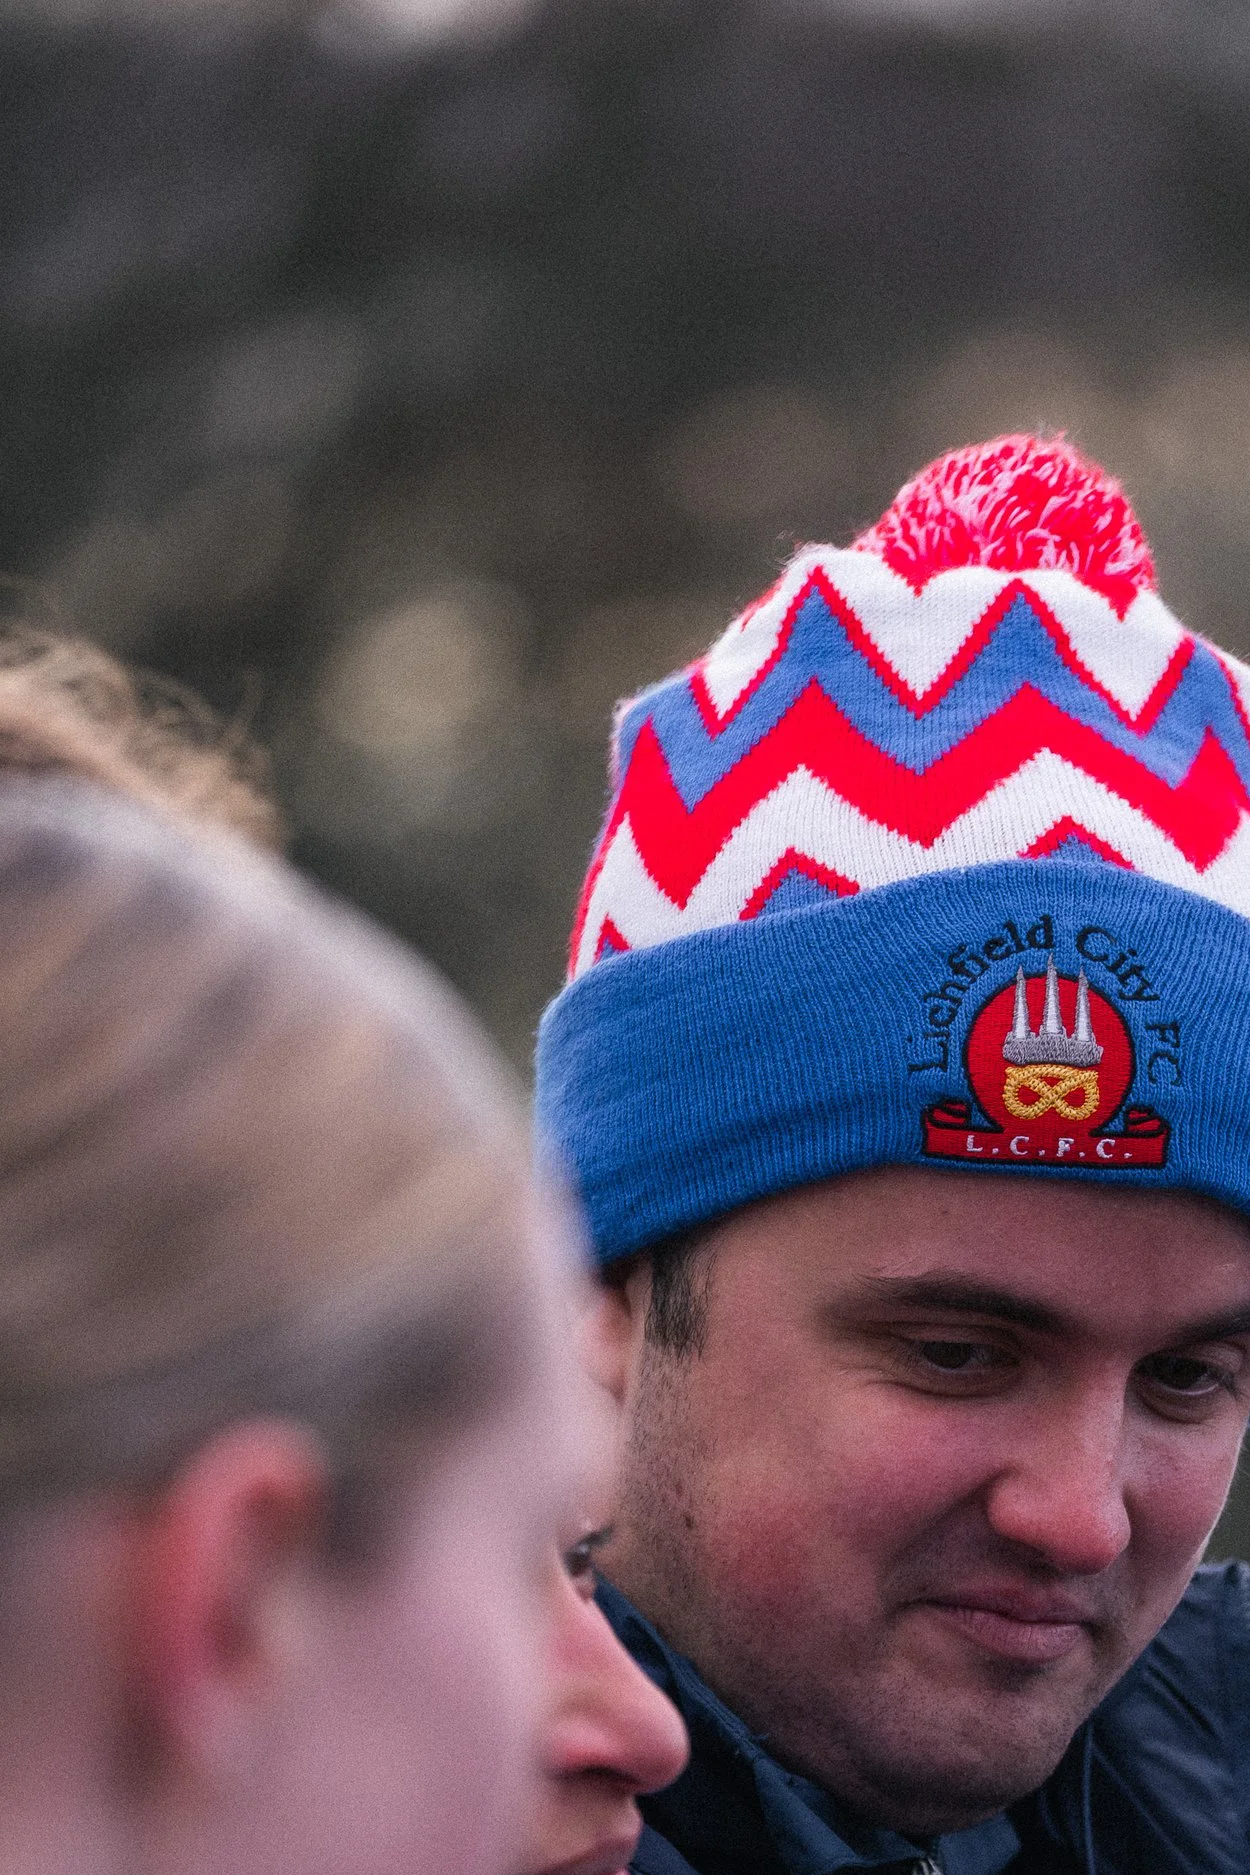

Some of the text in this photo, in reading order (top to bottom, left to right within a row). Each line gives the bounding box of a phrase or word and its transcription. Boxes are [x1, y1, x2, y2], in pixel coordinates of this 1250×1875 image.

[908, 914, 1182, 1087] Lichfield City FC
